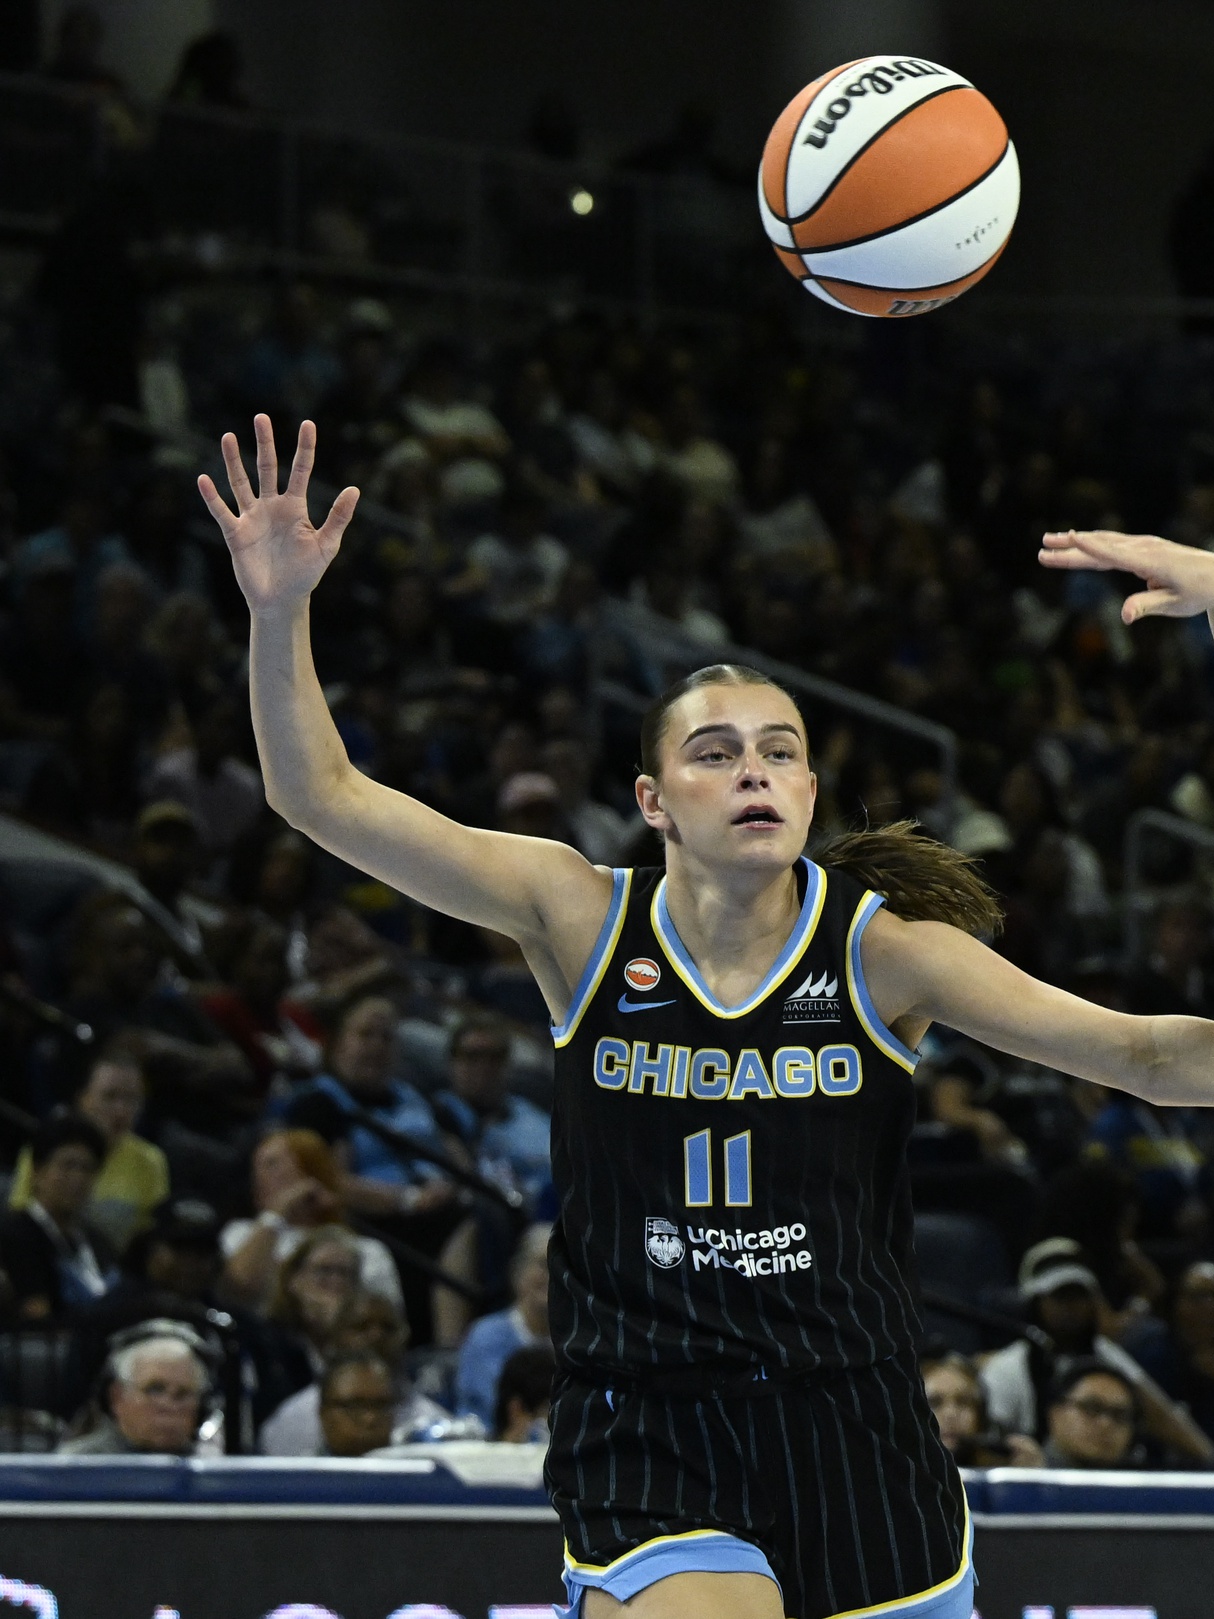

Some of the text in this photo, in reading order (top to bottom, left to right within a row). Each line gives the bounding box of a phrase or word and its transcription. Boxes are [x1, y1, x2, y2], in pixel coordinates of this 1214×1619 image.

[803, 60, 948, 149] Wilson
[783, 1001, 841, 1012] MAGELLAN
[593, 1036, 863, 1100] CHICAGO
[684, 1127, 752, 1207] 11
[692, 1249, 812, 1278] Medicine
